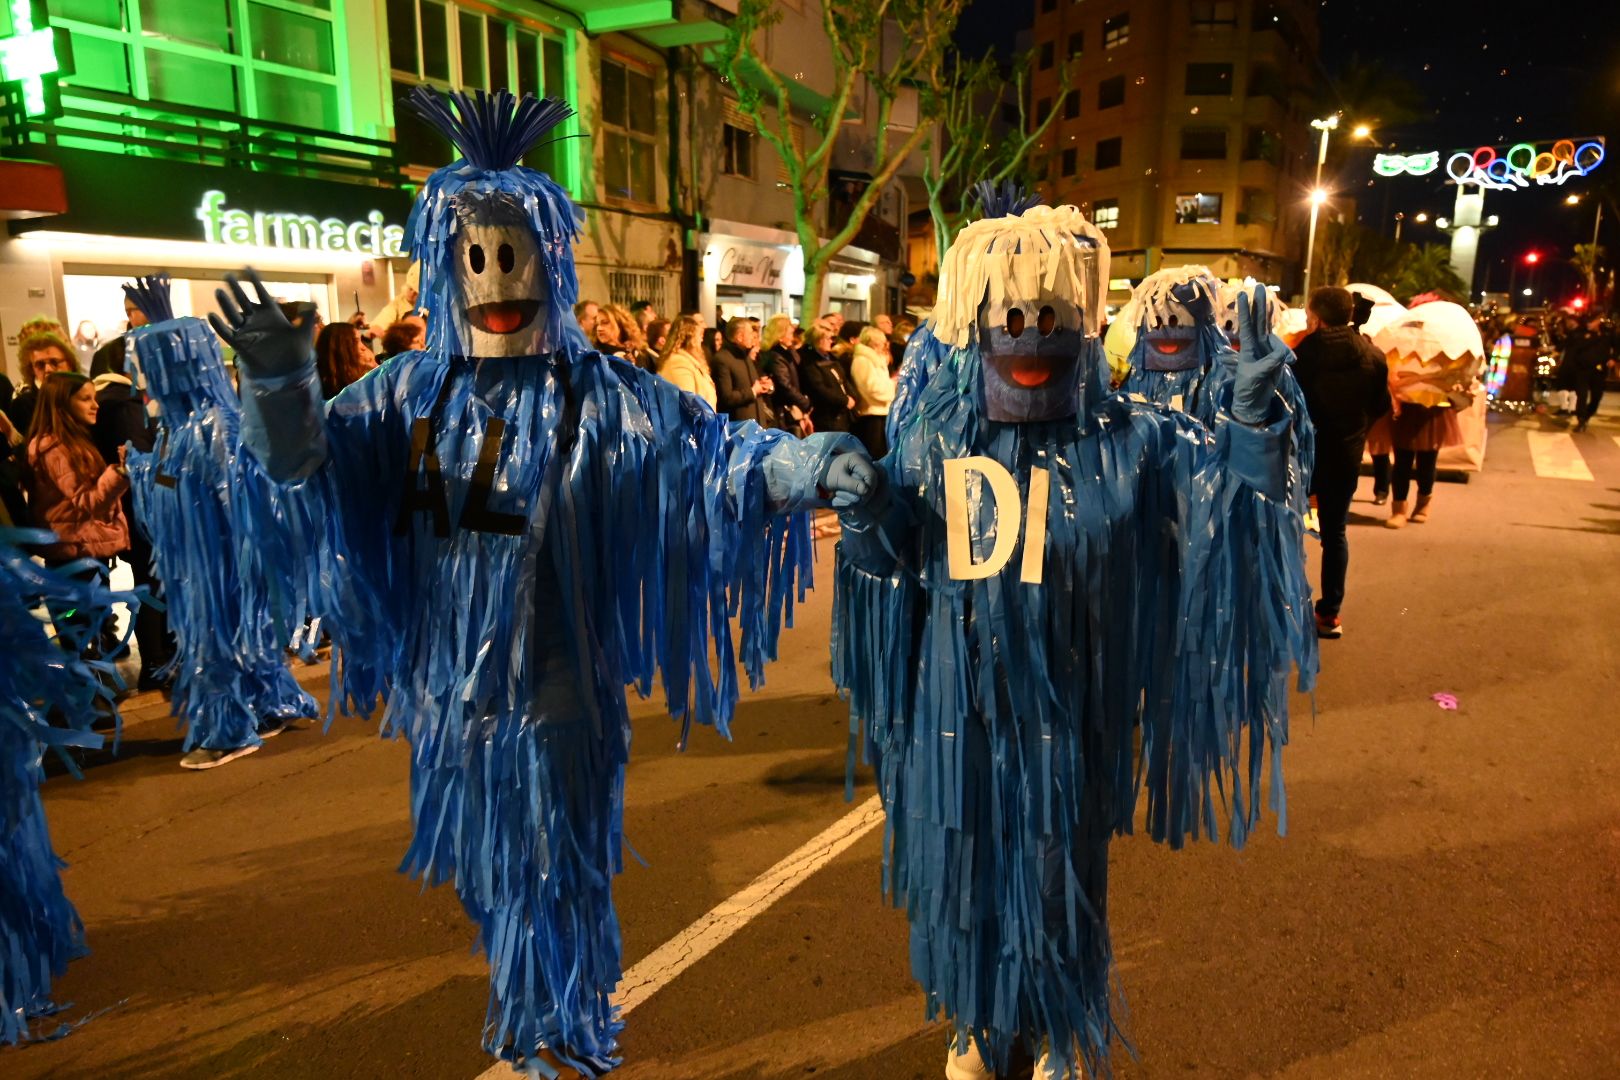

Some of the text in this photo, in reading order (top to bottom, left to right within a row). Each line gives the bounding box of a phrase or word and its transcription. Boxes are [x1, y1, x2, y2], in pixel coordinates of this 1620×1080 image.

[195, 190, 409, 257] farmacia
[393, 417, 529, 538] AL
[943, 456, 1049, 584] DI
